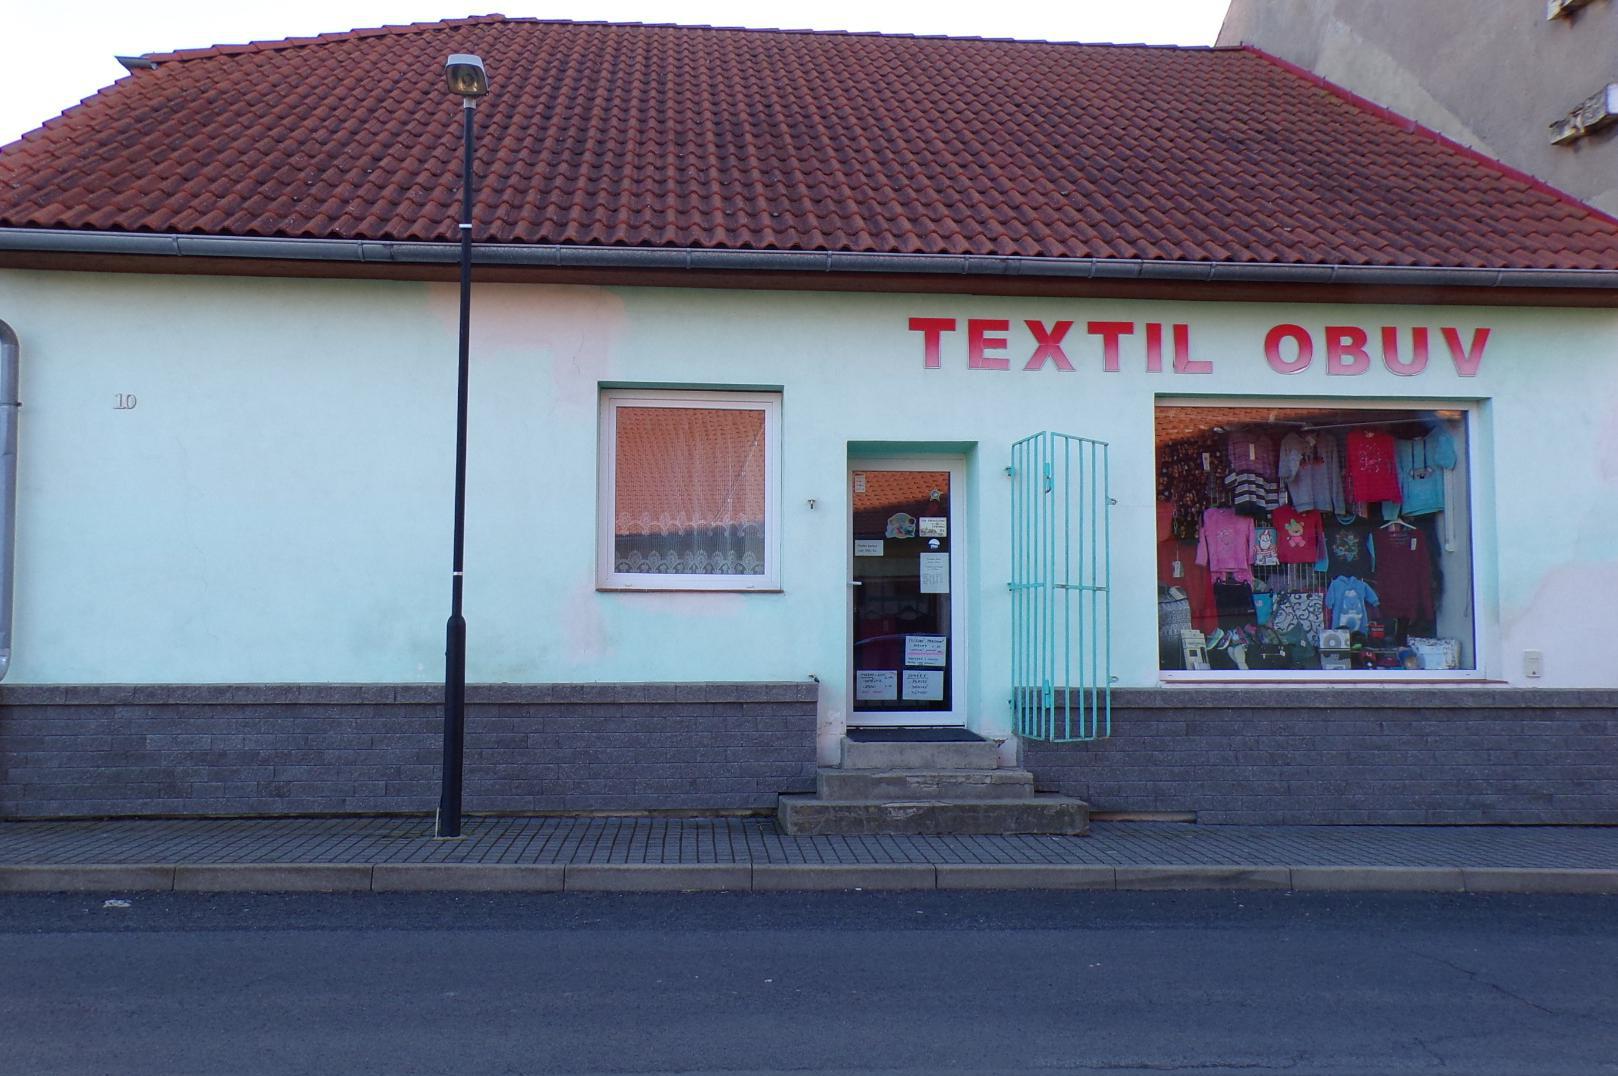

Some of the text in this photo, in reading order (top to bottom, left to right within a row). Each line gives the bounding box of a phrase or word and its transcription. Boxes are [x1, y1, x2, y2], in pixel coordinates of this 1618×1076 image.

[908, 317, 1492, 377] TEXTIL OBUV
[113, 393, 137, 410] 10
